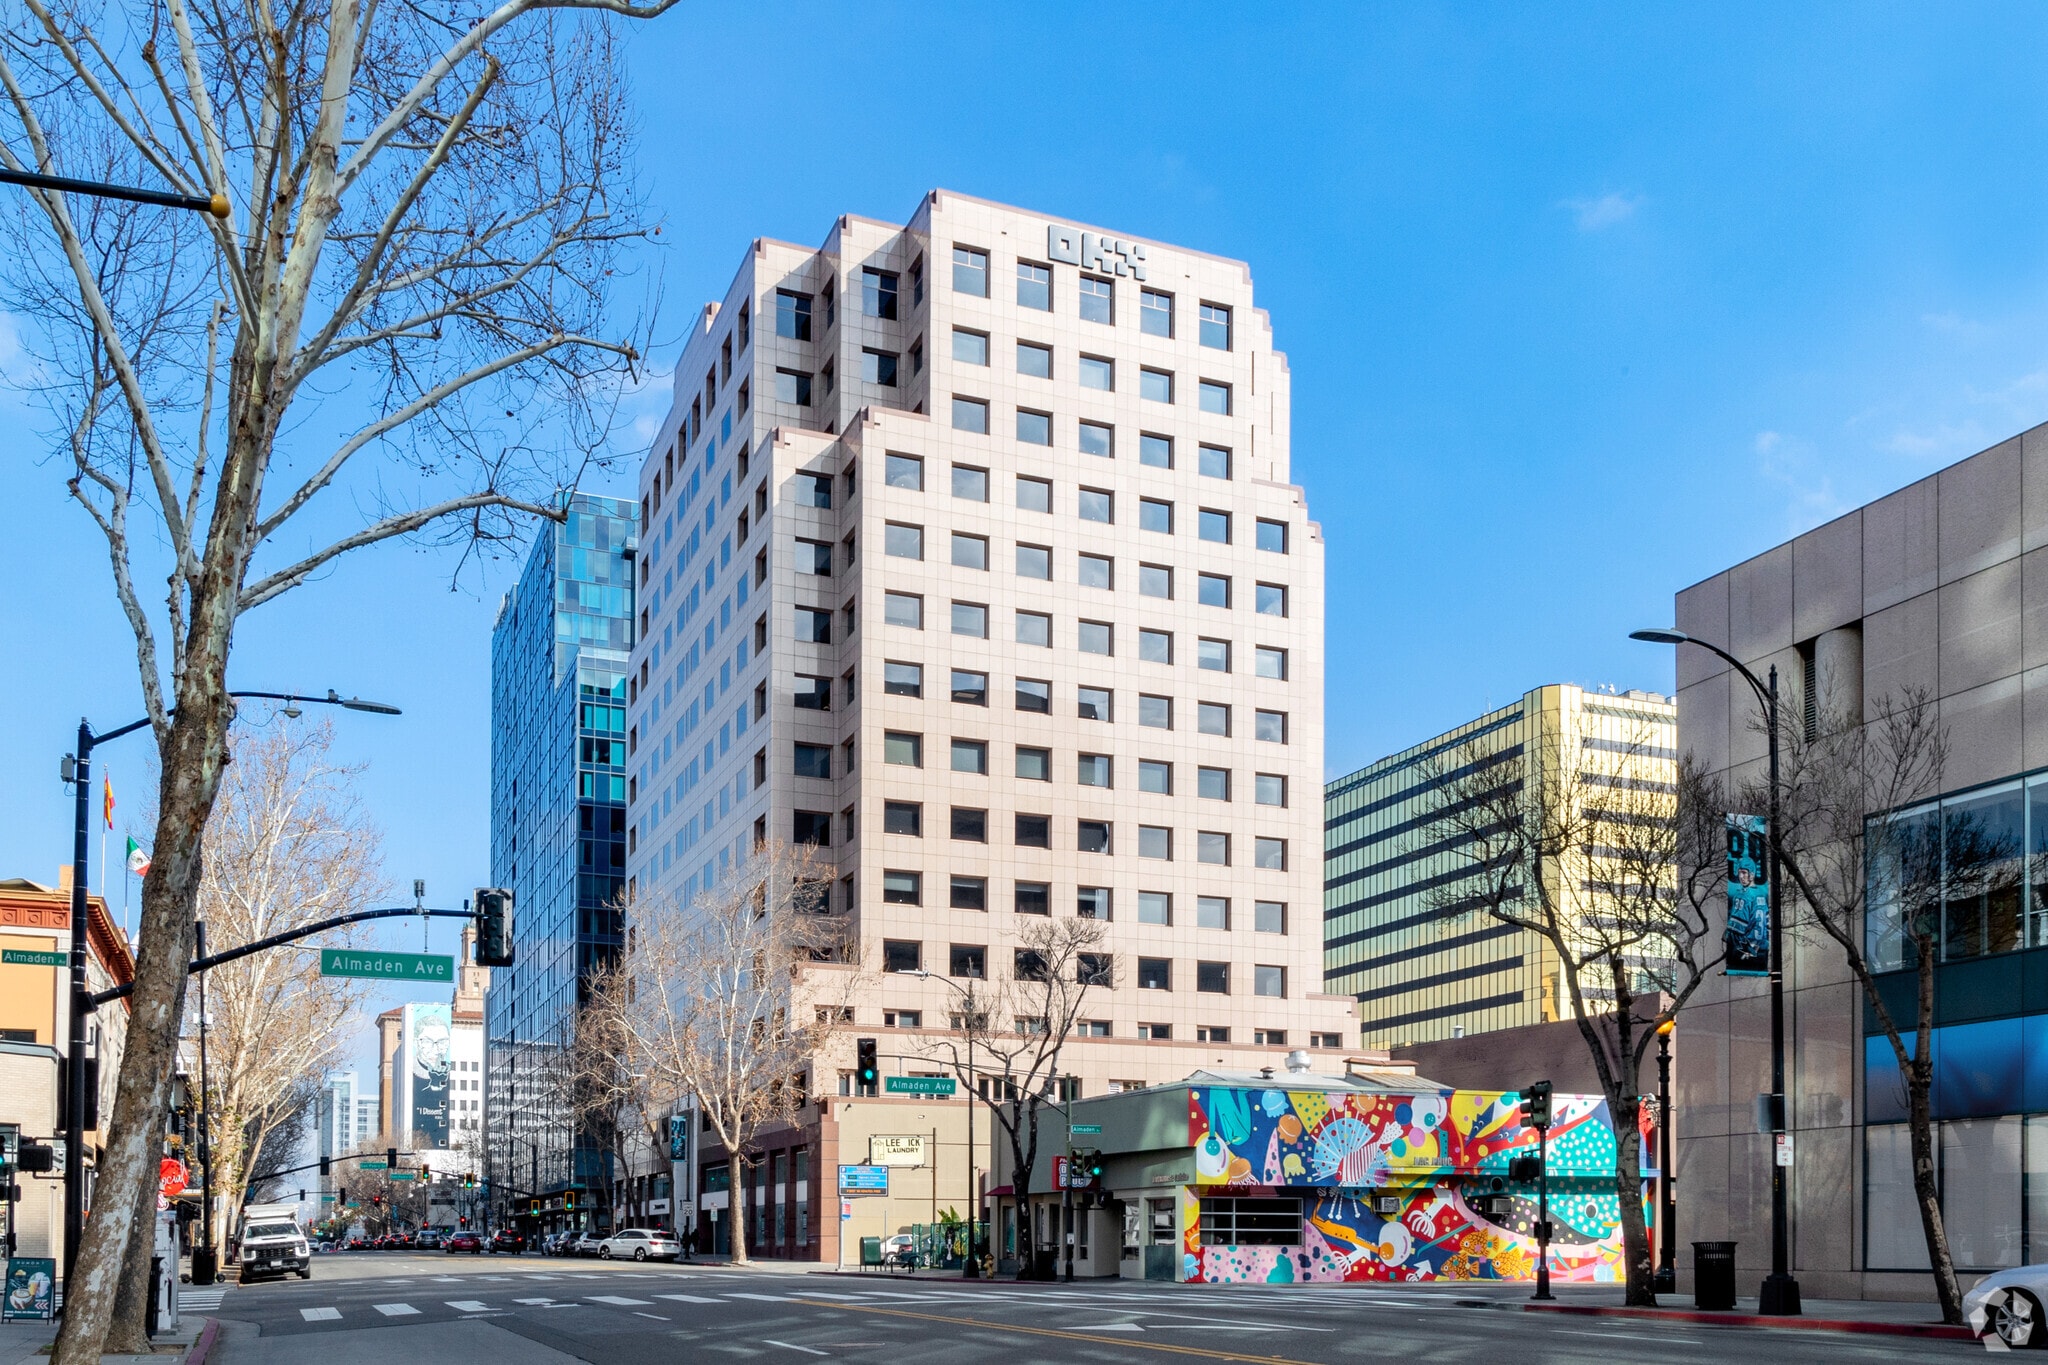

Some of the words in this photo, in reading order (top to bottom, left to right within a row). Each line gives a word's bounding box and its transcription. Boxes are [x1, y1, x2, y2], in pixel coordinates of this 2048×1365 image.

[1048, 224, 1146, 281] OKX
[4, 952, 54, 963] Almaden
[331, 956, 403, 973] Almaden
[414, 961, 445, 975] Ave
[891, 1080, 930, 1090] Almaden
[934, 1082, 951, 1091] Ave
[885, 1138, 901, 1147] LEE
[907, 1138, 920, 1147] ICK
[1059, 1177, 1085, 1187] PUC
